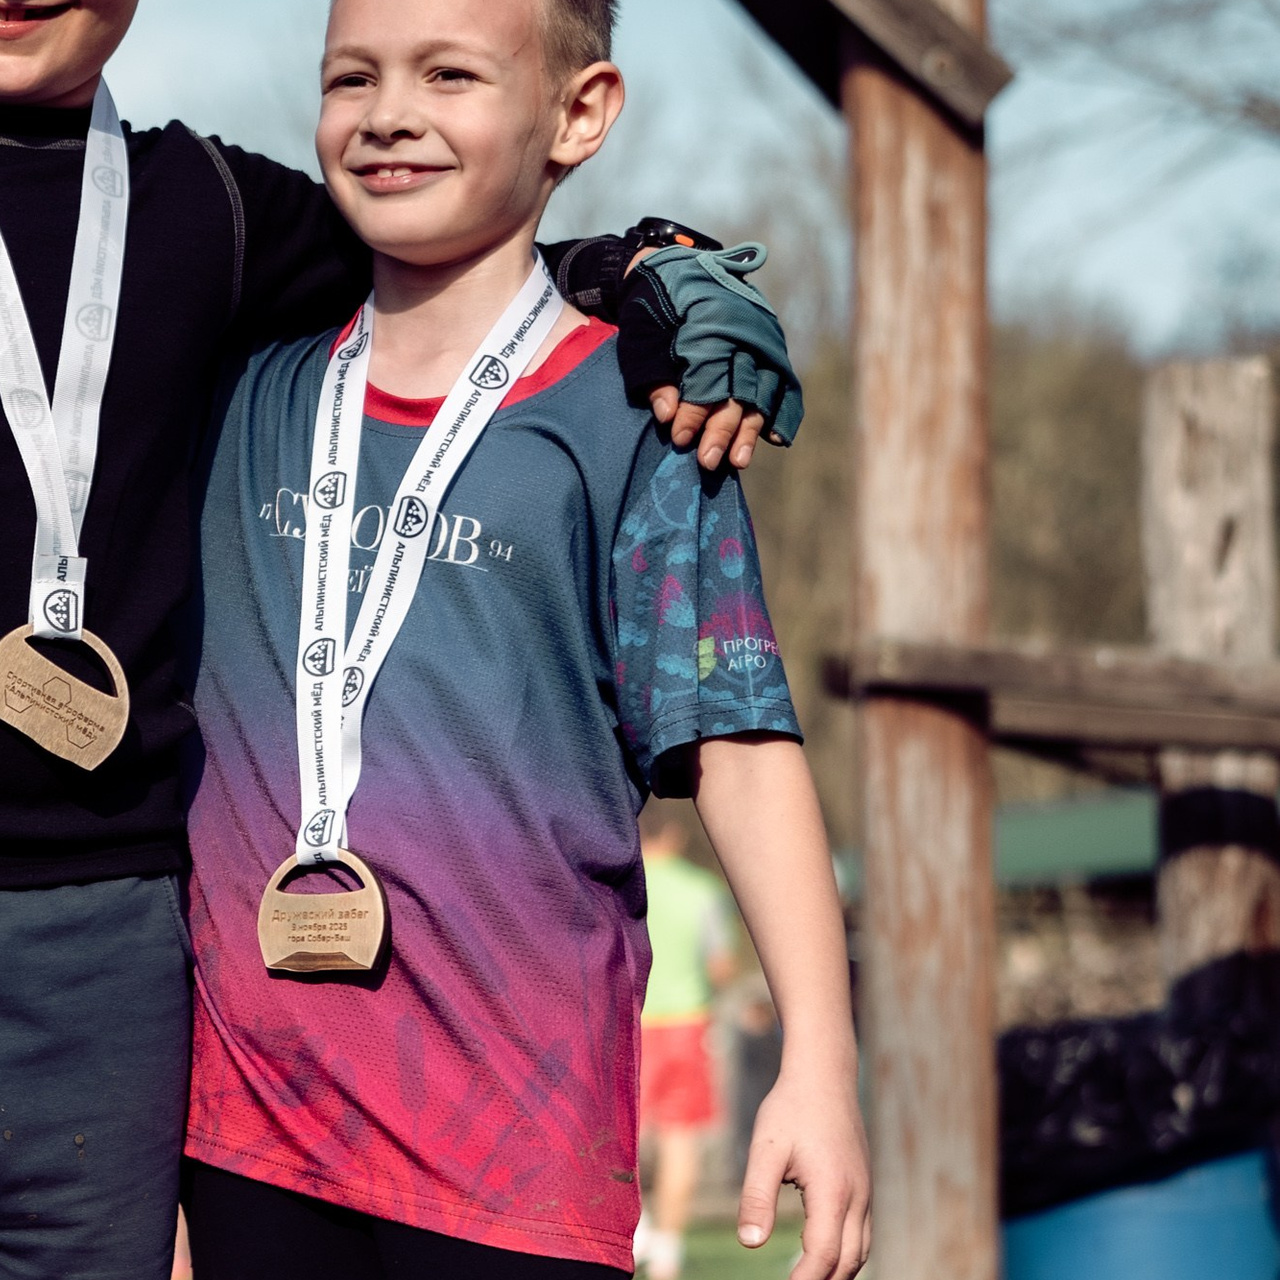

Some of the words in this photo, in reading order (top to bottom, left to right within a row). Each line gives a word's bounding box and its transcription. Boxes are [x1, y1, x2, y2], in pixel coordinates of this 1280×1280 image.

[513, 285, 554, 343] АЛЬПИНИСТСКИЙ
[499, 335, 518, 359] МЁД
[327, 384, 346, 466] АЛЬПИНИСТСКИЙ
[337, 361, 350, 385] МЁД
[429, 389, 482, 469] АЛЬПИНИСТСКИЙ
[415, 469, 435, 493] МЁД
[320, 513, 333, 541] МЁД
[488, 539, 514, 562] 94
[314, 543, 329, 632] АЛЬПИНИСТСКИЙ
[370, 540, 406, 638] АЛЬПИНИСТСКИЙ
[356, 638, 375, 663] МЁД
[727, 653, 767, 672] АГРО
[7, 671, 57, 703] Спортивная
[57, 702, 106, 733] агроферма
[311, 681, 324, 707] МЁД
[311, 709, 327, 806] АЛЬПИНИСТСКИЙ
[272, 909, 334, 921] Дружеский
[338, 909, 369, 919] забег
[298, 922, 327, 932] ноября
[329, 922, 348, 931] 2025
[287, 934, 306, 943] гора
[307, 933, 352, 943] Собер-Баш
